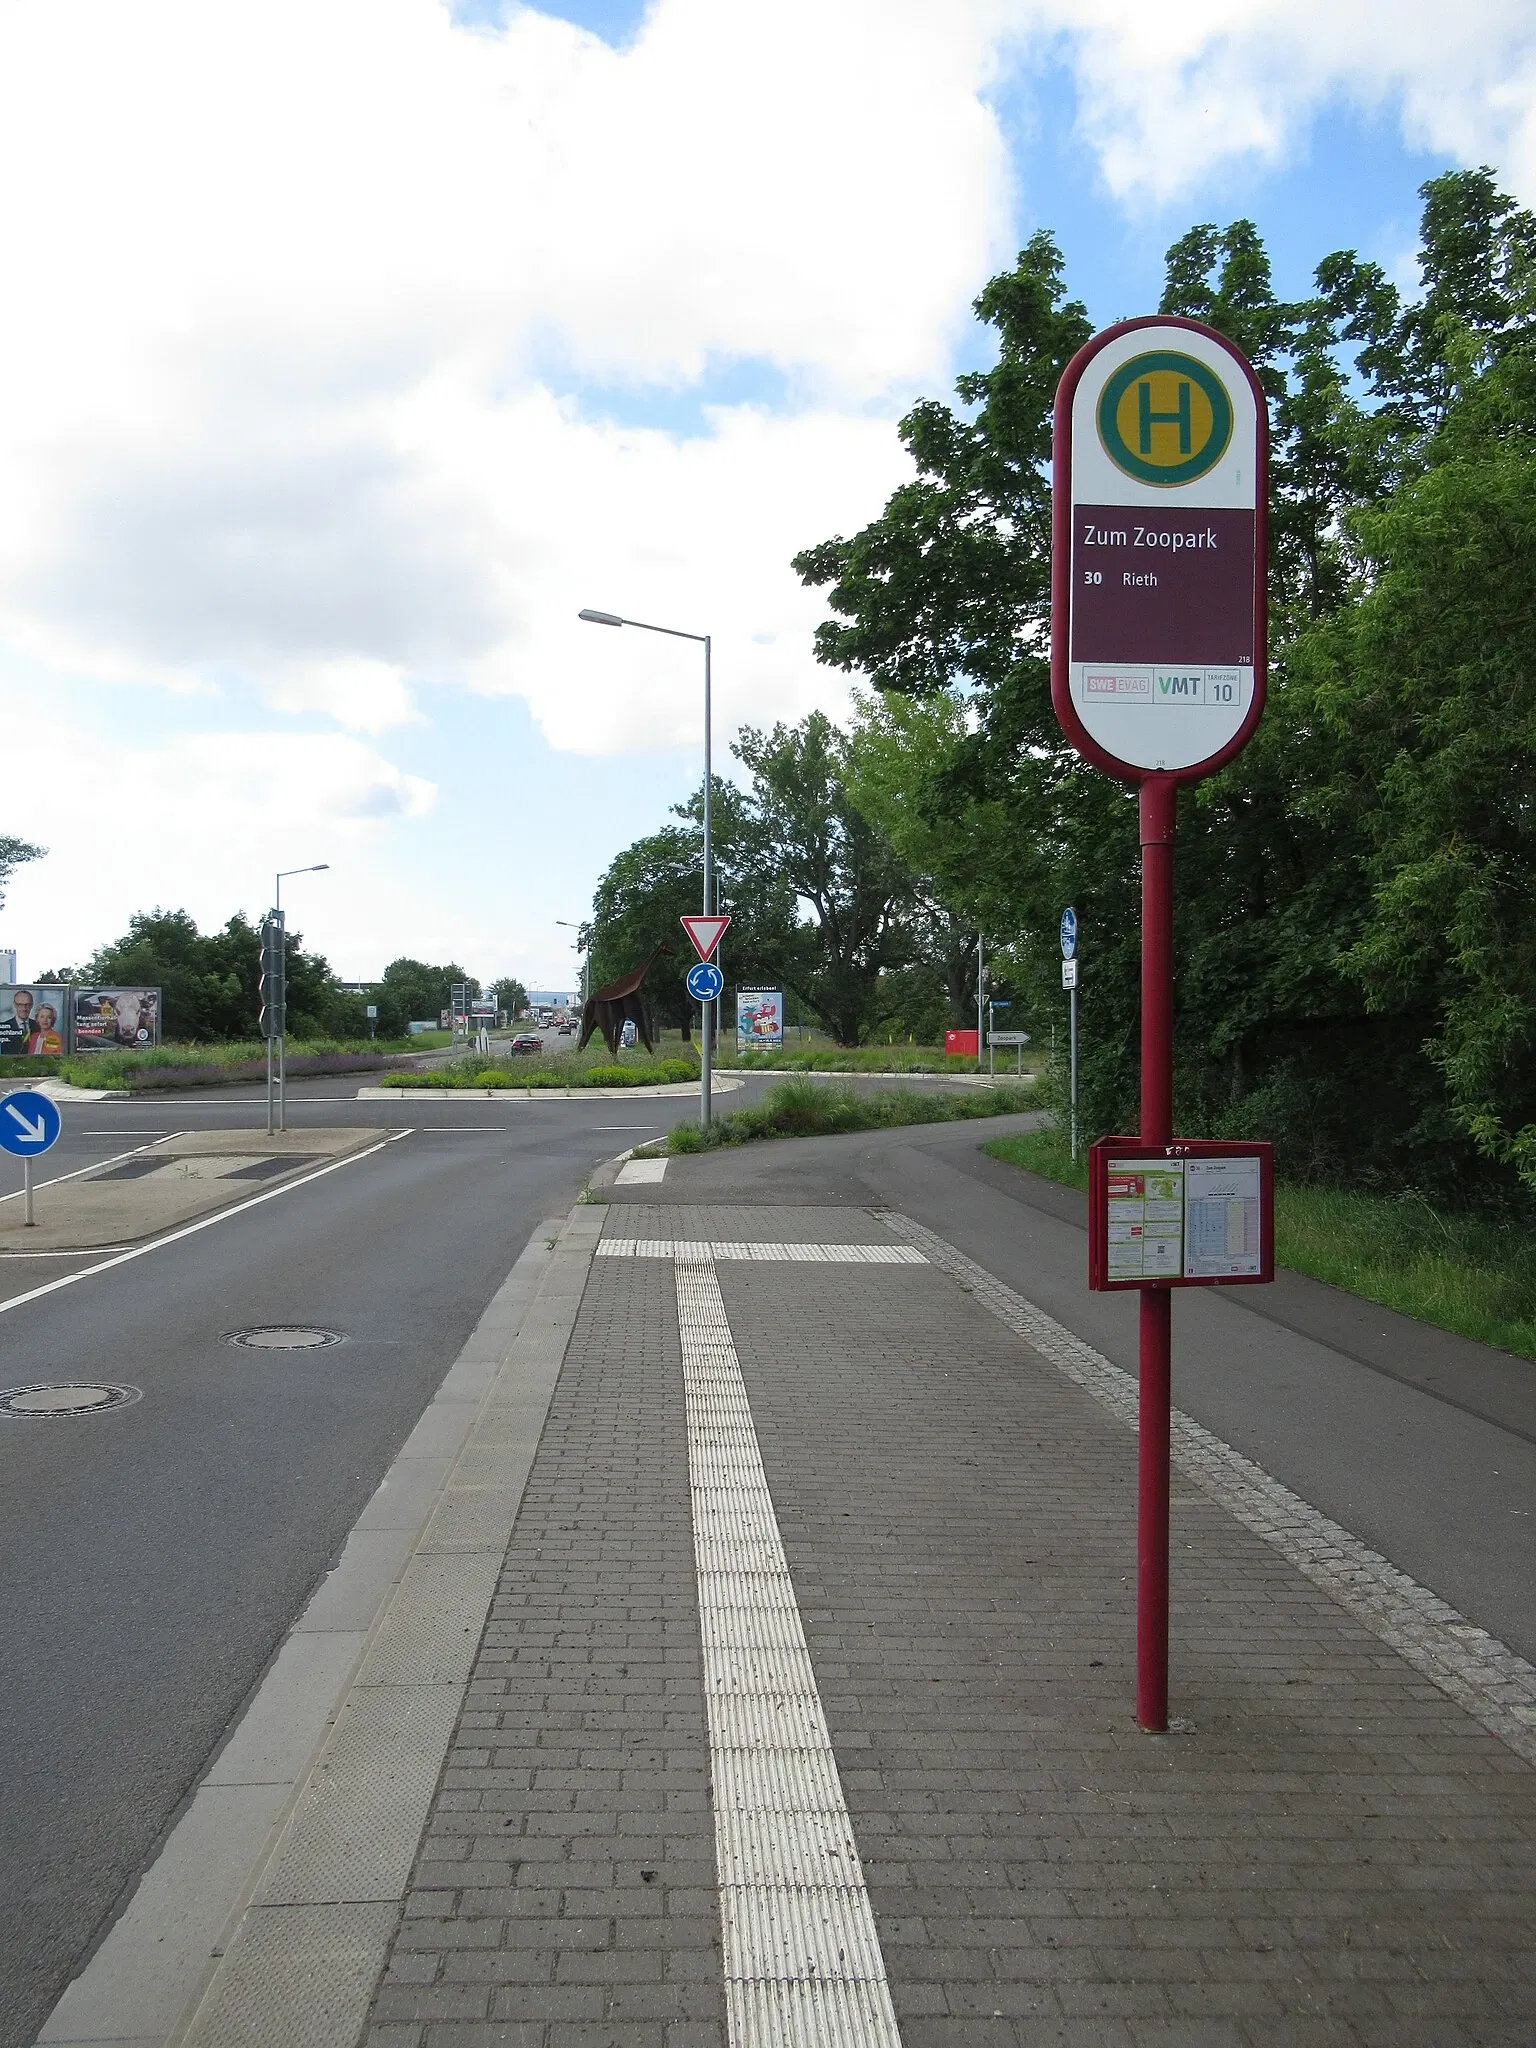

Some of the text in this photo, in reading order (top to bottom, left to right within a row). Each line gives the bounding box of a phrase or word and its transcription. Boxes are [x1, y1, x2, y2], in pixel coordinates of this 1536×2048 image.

[1138, 382, 1191, 455] H
[1084, 525, 1218, 552] Zum Zoopark
[1084, 571, 1158, 586] 30 Rieth
[1238, 655, 1251, 664] 218
[1088, 678, 1147, 691] SWE EVAG
[1158, 676, 1201, 696] VMT
[1207, 674, 1239, 682] TARIFZONE
[1213, 684, 1232, 702] 10
